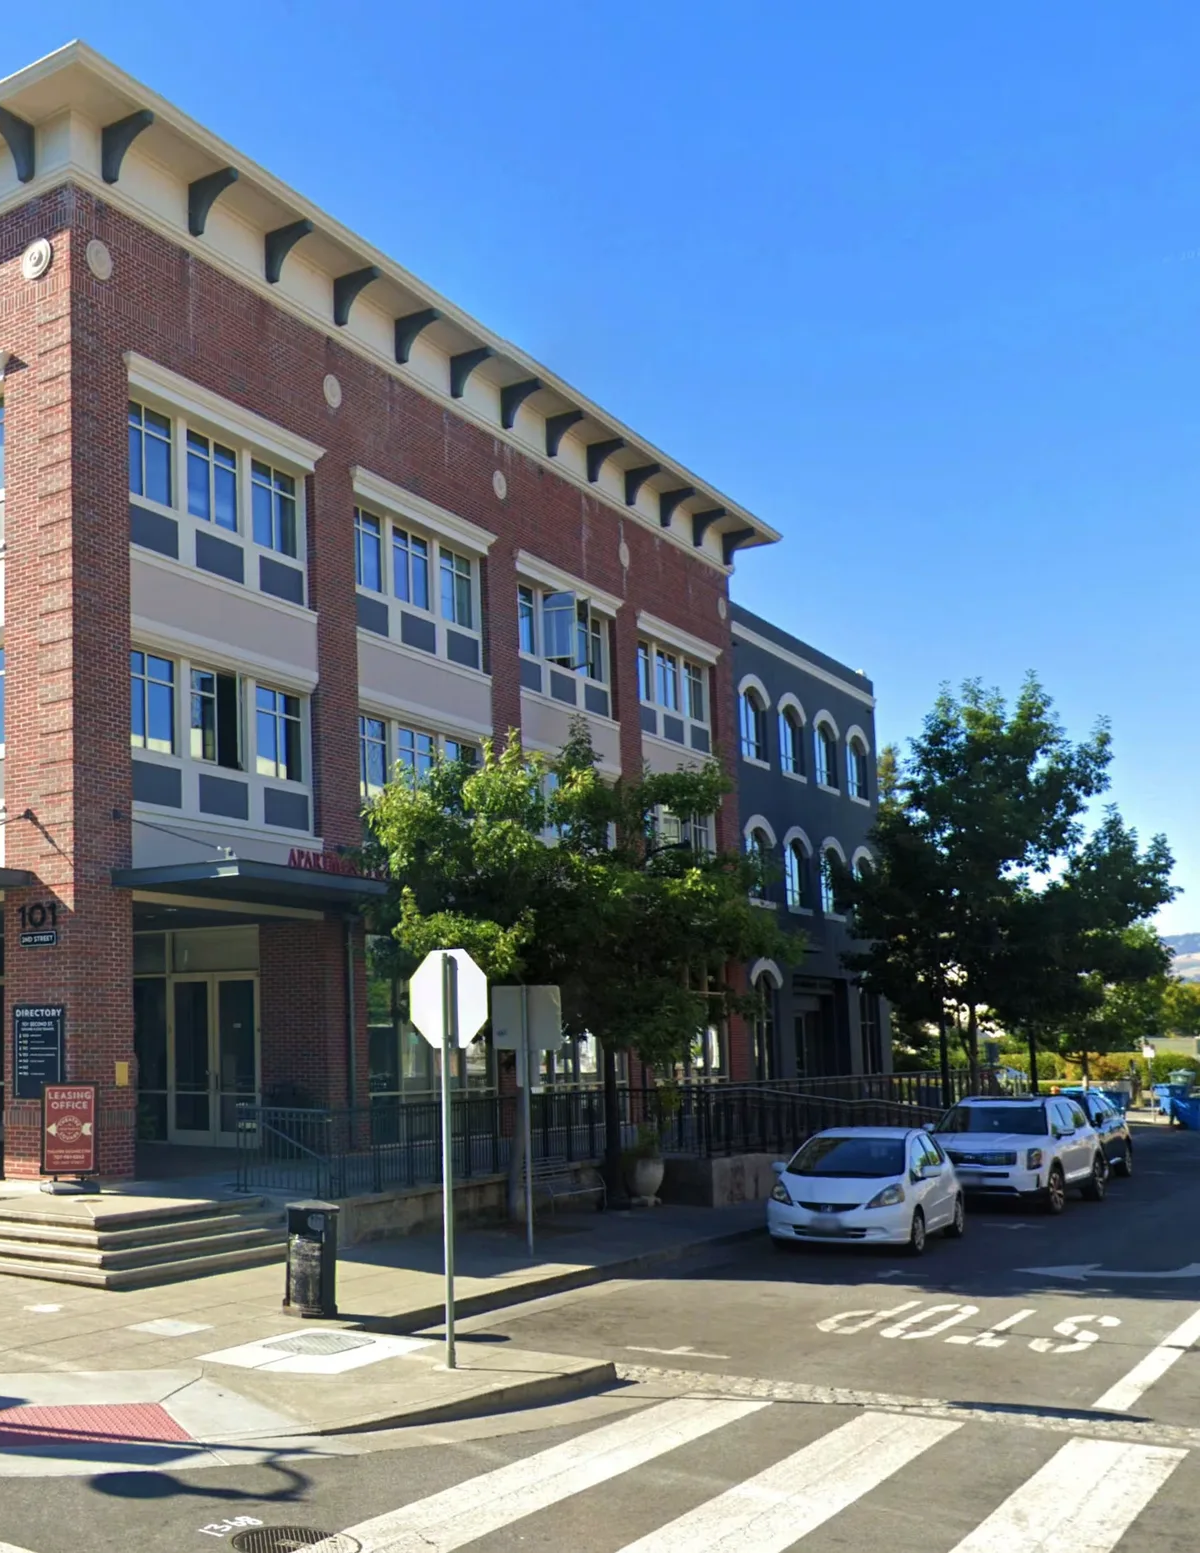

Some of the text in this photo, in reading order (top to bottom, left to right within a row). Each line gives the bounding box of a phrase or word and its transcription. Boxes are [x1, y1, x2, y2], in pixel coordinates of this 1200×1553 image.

[18, 901, 57, 928] 101
[34, 935, 53, 943] STREET
[15, 1009, 62, 1017] DIRECTORY
[48, 1091, 92, 1100] LEASING
[50, 1101, 88, 1110] OFFICE
[816, 1301, 1122, 1353] STOP
